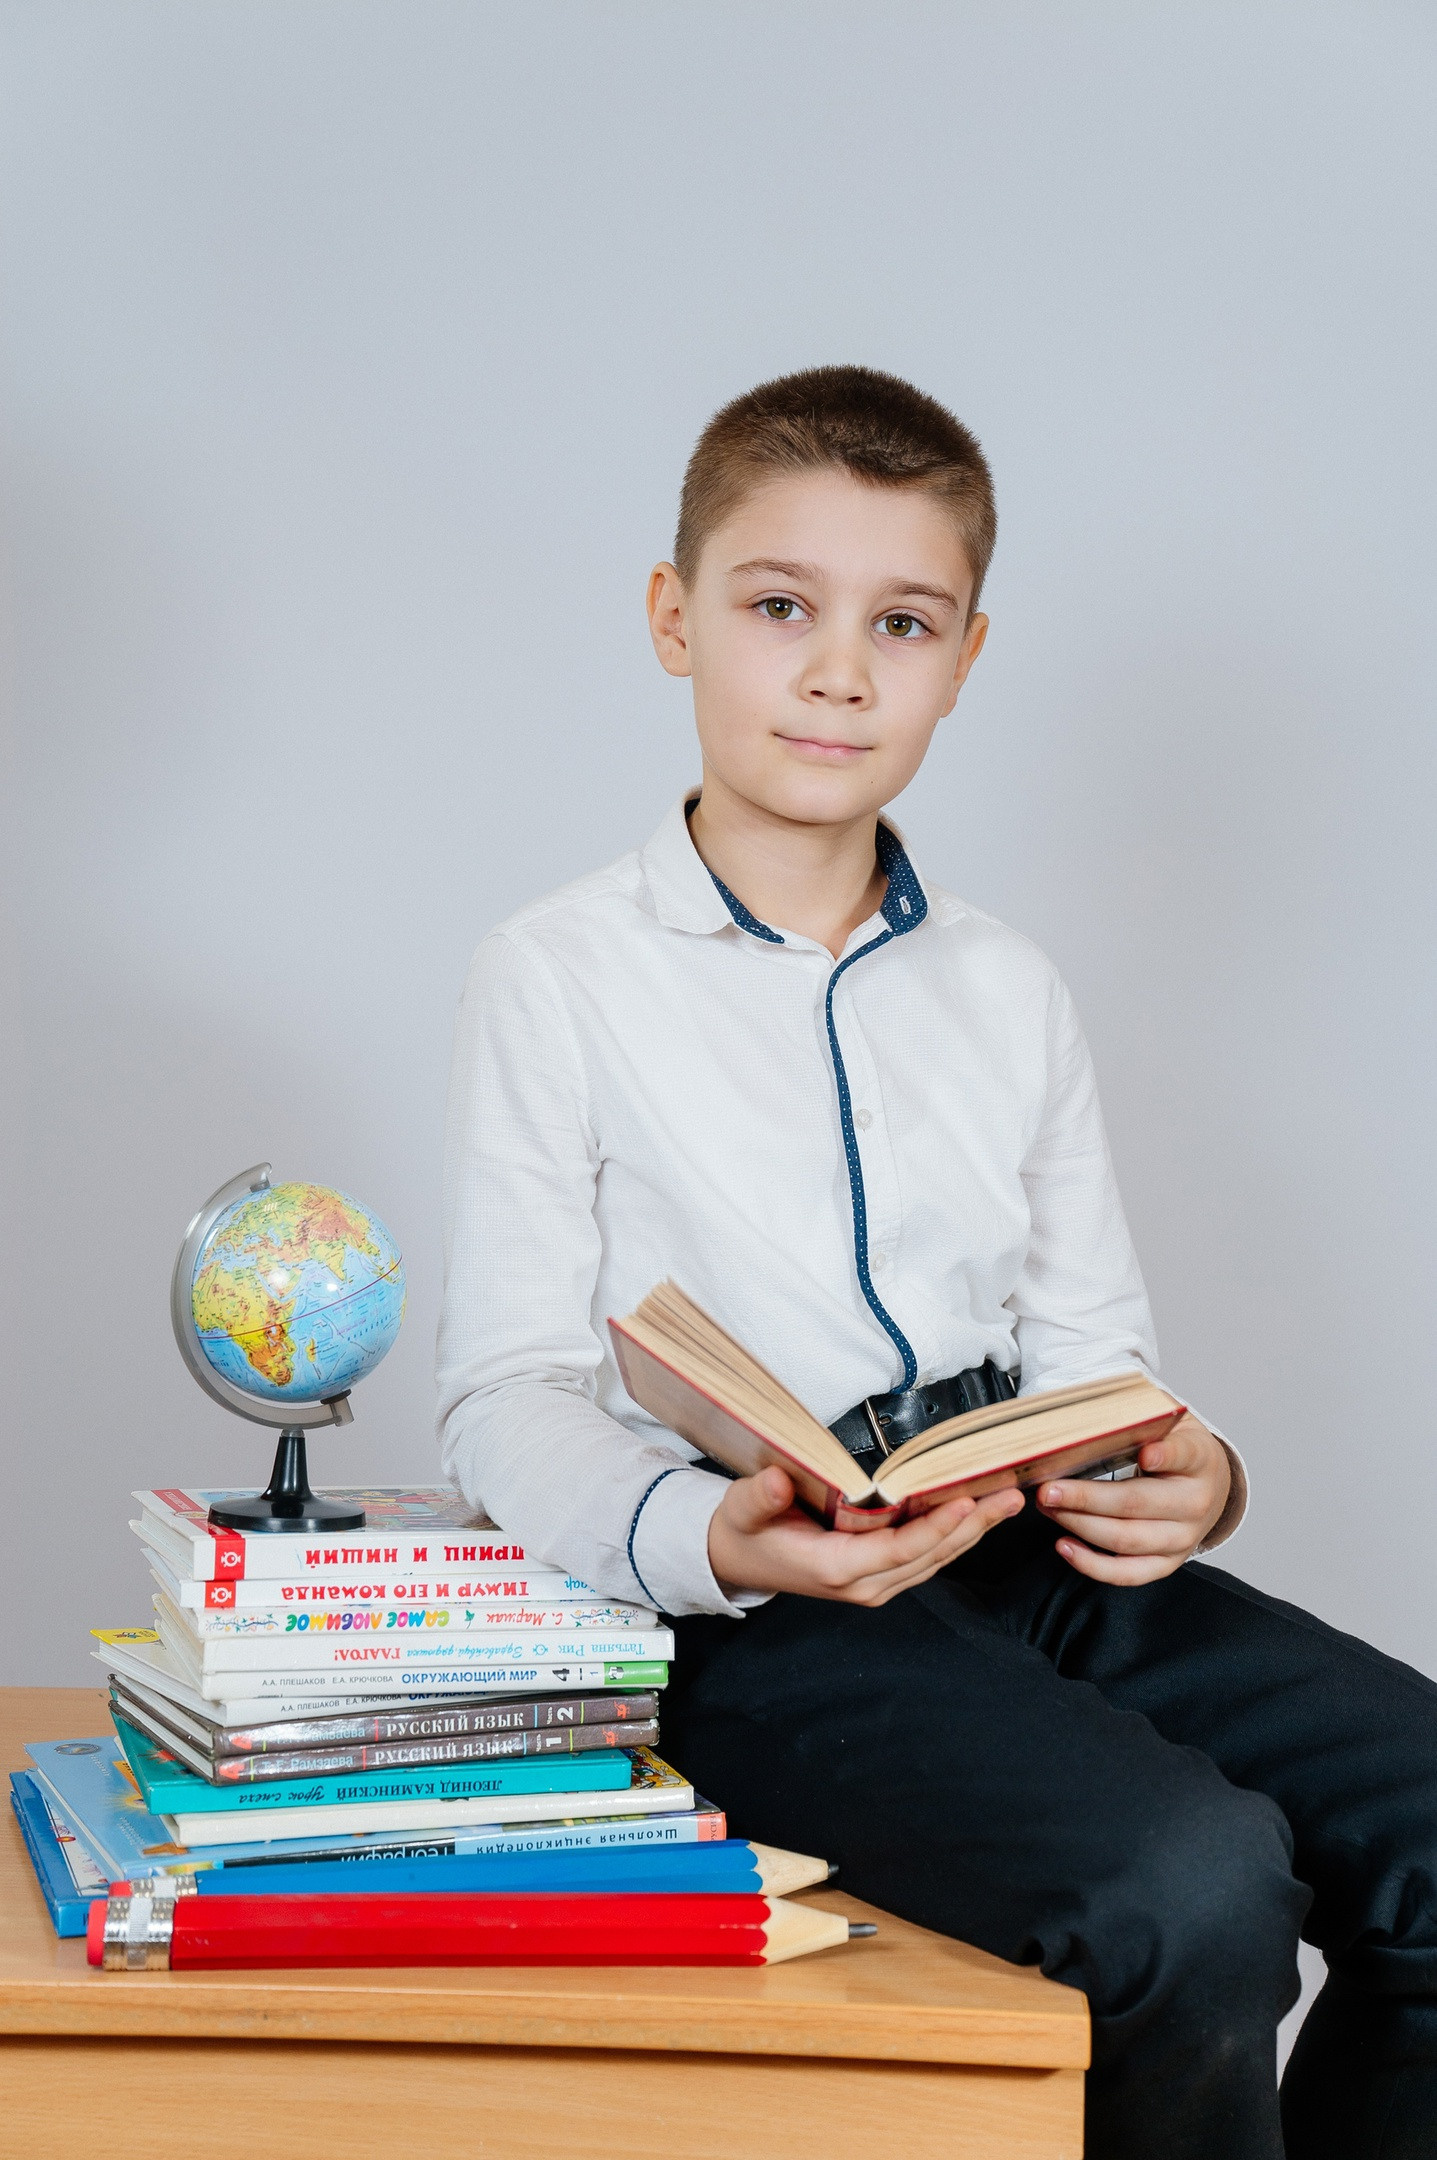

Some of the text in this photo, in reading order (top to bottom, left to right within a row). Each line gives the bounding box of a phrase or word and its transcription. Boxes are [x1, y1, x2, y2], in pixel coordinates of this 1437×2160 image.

[305, 1545, 525, 1569] ПРИНЦ И НИЩИЙ
[393, 1584, 428, 1599] ЕГО
[436, 1583, 450, 1598] И
[457, 1581, 529, 1598] ТИМУР
[284, 1609, 450, 1632] САМОЕ ЛЮБИМОЕ
[486, 1607, 547, 1626] Маршак
[557, 1642, 646, 1657] Татьяна Рик
[280, 1677, 326, 1686] ПЛЕШАКОВ
[350, 1675, 393, 1684] КРЮЧКОВА
[401, 1669, 538, 1685] ОКРУЖАЮЩИЙ МИР
[552, 1668, 570, 1682] 4
[297, 1700, 340, 1712] ПЛЕШАКОВ
[557, 1706, 574, 1721] 2
[386, 1712, 524, 1738] РУССКИЙ ЯЗЫК
[546, 1736, 562, 1748] 1
[374, 1739, 515, 1765] РУССКИЙ ЯЗЫК
[239, 1785, 325, 1804] Урок смеха
[336, 1779, 503, 1800] ЛЕОНИД КАМИНСКИЙ
[476, 1829, 677, 1854] Школьная энциклопедия
